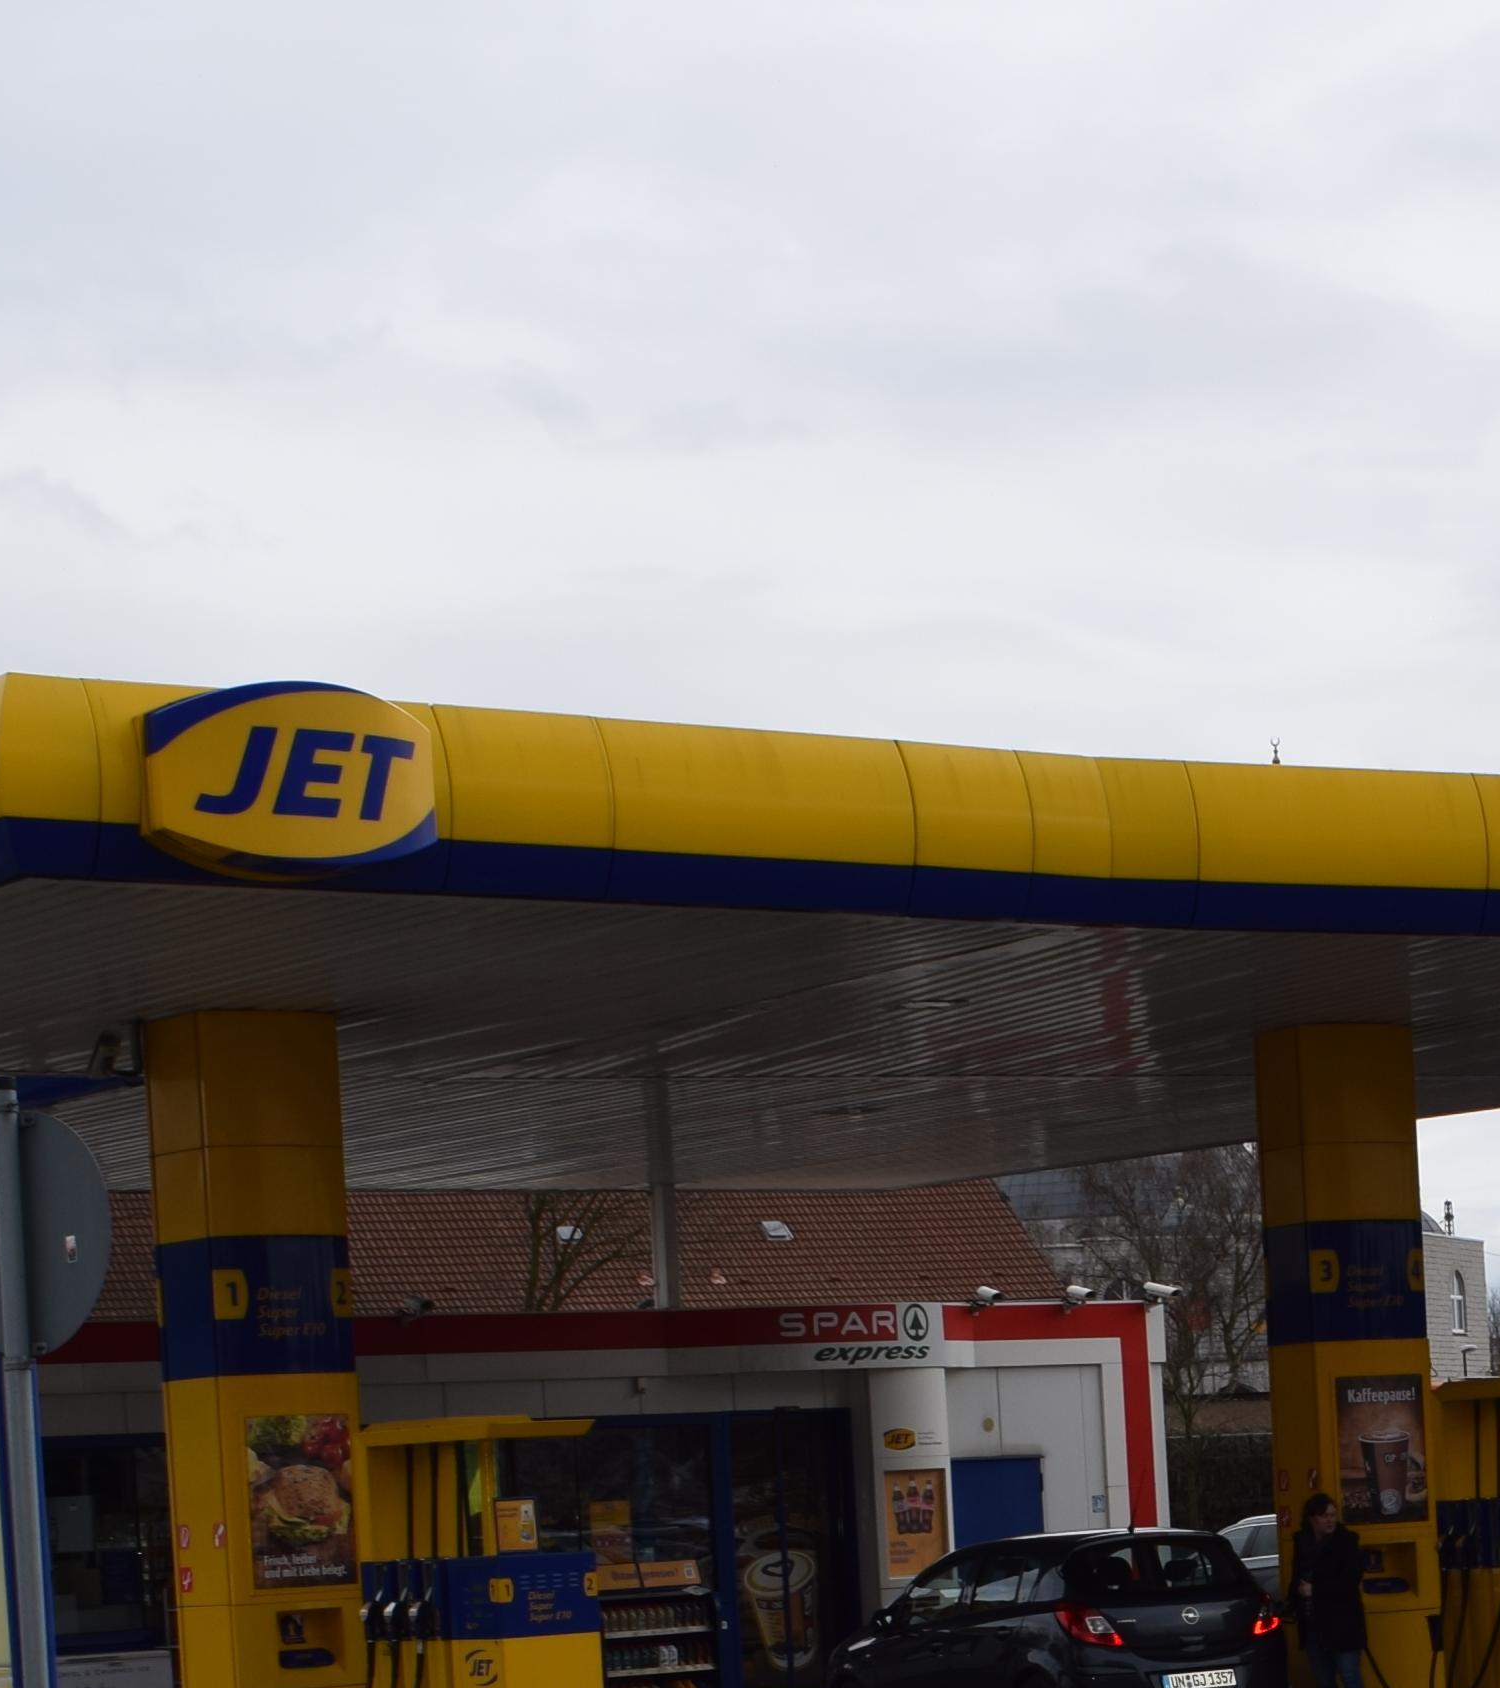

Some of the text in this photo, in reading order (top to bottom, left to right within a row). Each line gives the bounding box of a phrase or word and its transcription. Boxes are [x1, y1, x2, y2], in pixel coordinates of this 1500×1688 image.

[195, 726, 415, 821] JET
[1320, 1258, 1333, 1282] 3
[224, 1280, 239, 1306] 1
[256, 1286, 301, 1301] Diesel
[335, 1280, 348, 1305] 2
[257, 1305, 299, 1321] Super
[258, 1322, 327, 1340] Super E10
[779, 1311, 896, 1338] SPAR
[814, 1345, 929, 1365] express
[1347, 1386, 1416, 1405] Kaffeepause!
[264, 1567, 281, 1579] und
[282, 1566, 298, 1577] mit
[299, 1564, 321, 1577] Liebe
[528, 1601, 554, 1612] Super
[528, 1612, 553, 1623] Super
[469, 1659, 494, 1677] JET
[1170, 1671, 1234, 1688] UN GJ 1357
